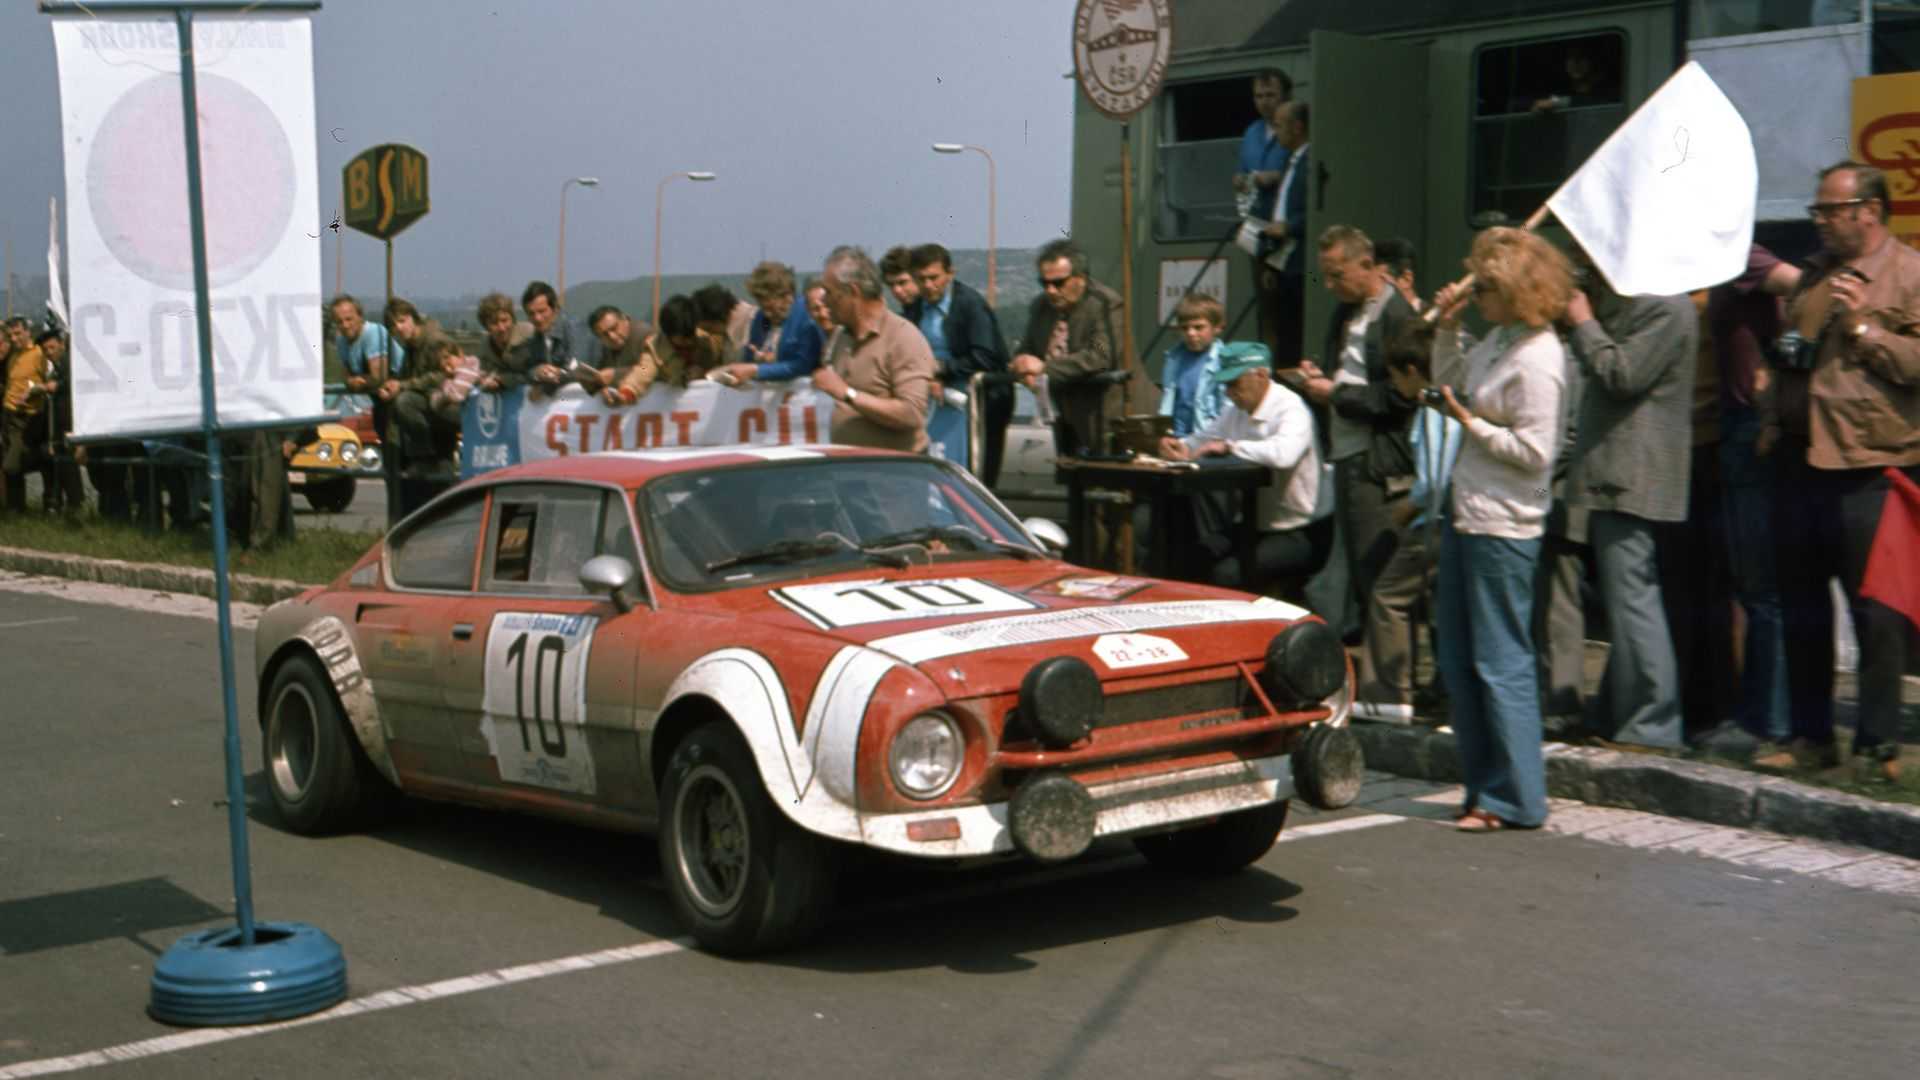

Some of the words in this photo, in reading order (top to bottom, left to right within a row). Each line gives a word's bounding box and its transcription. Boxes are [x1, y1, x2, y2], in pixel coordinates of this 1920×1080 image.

[347, 150, 422, 232] BSM
[834, 583, 984, 611] 10
[506, 631, 567, 758] 10
